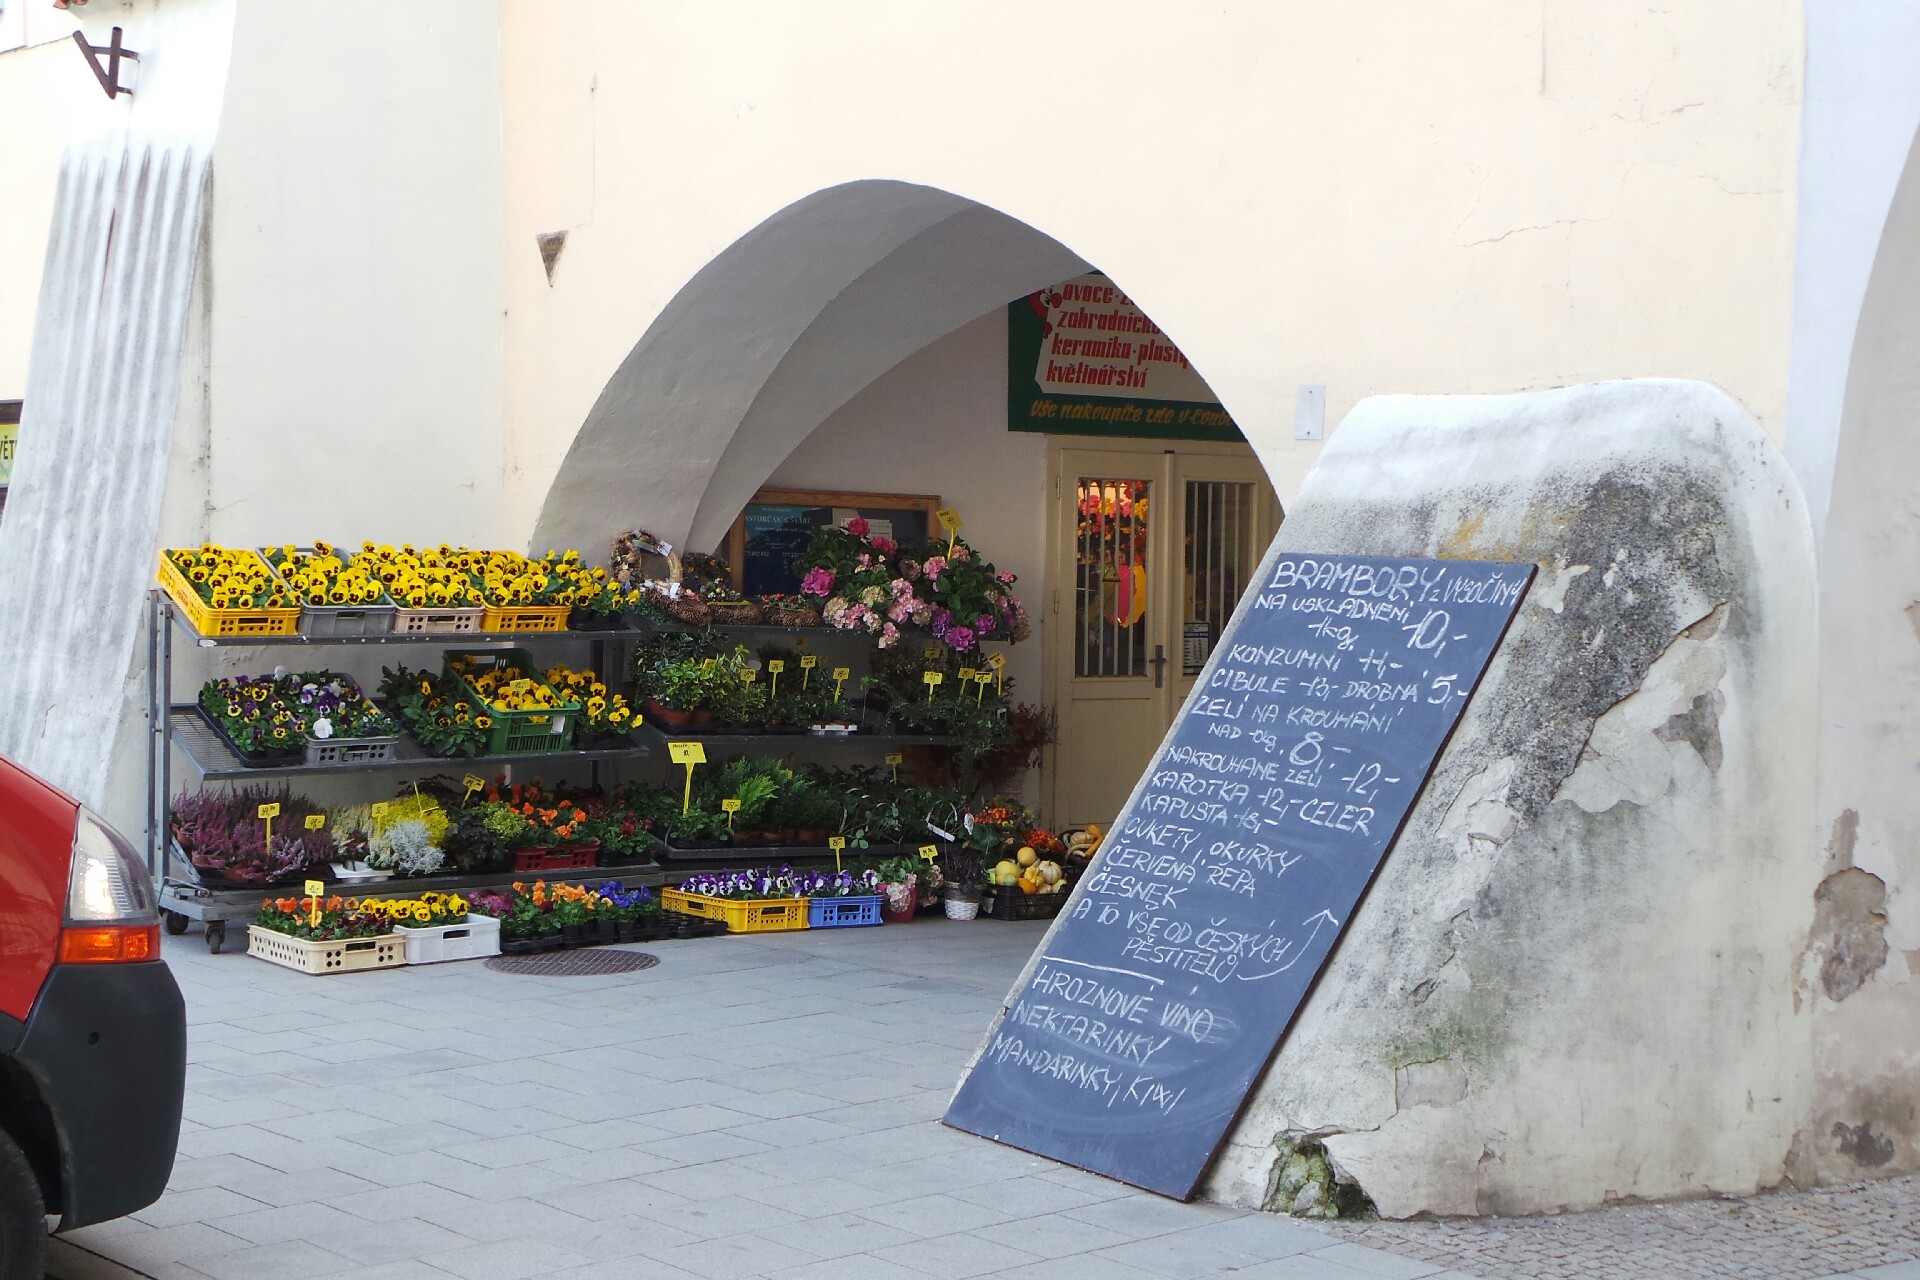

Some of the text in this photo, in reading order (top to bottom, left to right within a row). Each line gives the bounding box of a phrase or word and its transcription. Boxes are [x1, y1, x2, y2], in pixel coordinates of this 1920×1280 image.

[1051, 333, 1131, 359] keramika
[1046, 360, 1149, 388] květinářství
[1255, 594, 1287, 610] NA
[1269, 560, 1446, 602] BRAMBORY
[1443, 572, 1527, 606] VYSOČINY
[1211, 668, 1290, 694] CIBULE
[1191, 693, 1404, 735] ZELÍ NA KROUHÁNÍ
[1208, 722, 1242, 739] NAD
[1140, 793, 1228, 826] KAPUSTA
[1151, 771, 1250, 805] KAROTKA
[1299, 798, 1375, 837] CELER
[1209, 840, 1303, 879] OKURKY
[1086, 866, 1188, 909] ČESNEK
[1072, 898, 1093, 919] A
[1163, 922, 1193, 943] OD
[1195, 917, 1293, 963] ČESKÝCH
[1011, 999, 1172, 1068] NEKTARINKY
